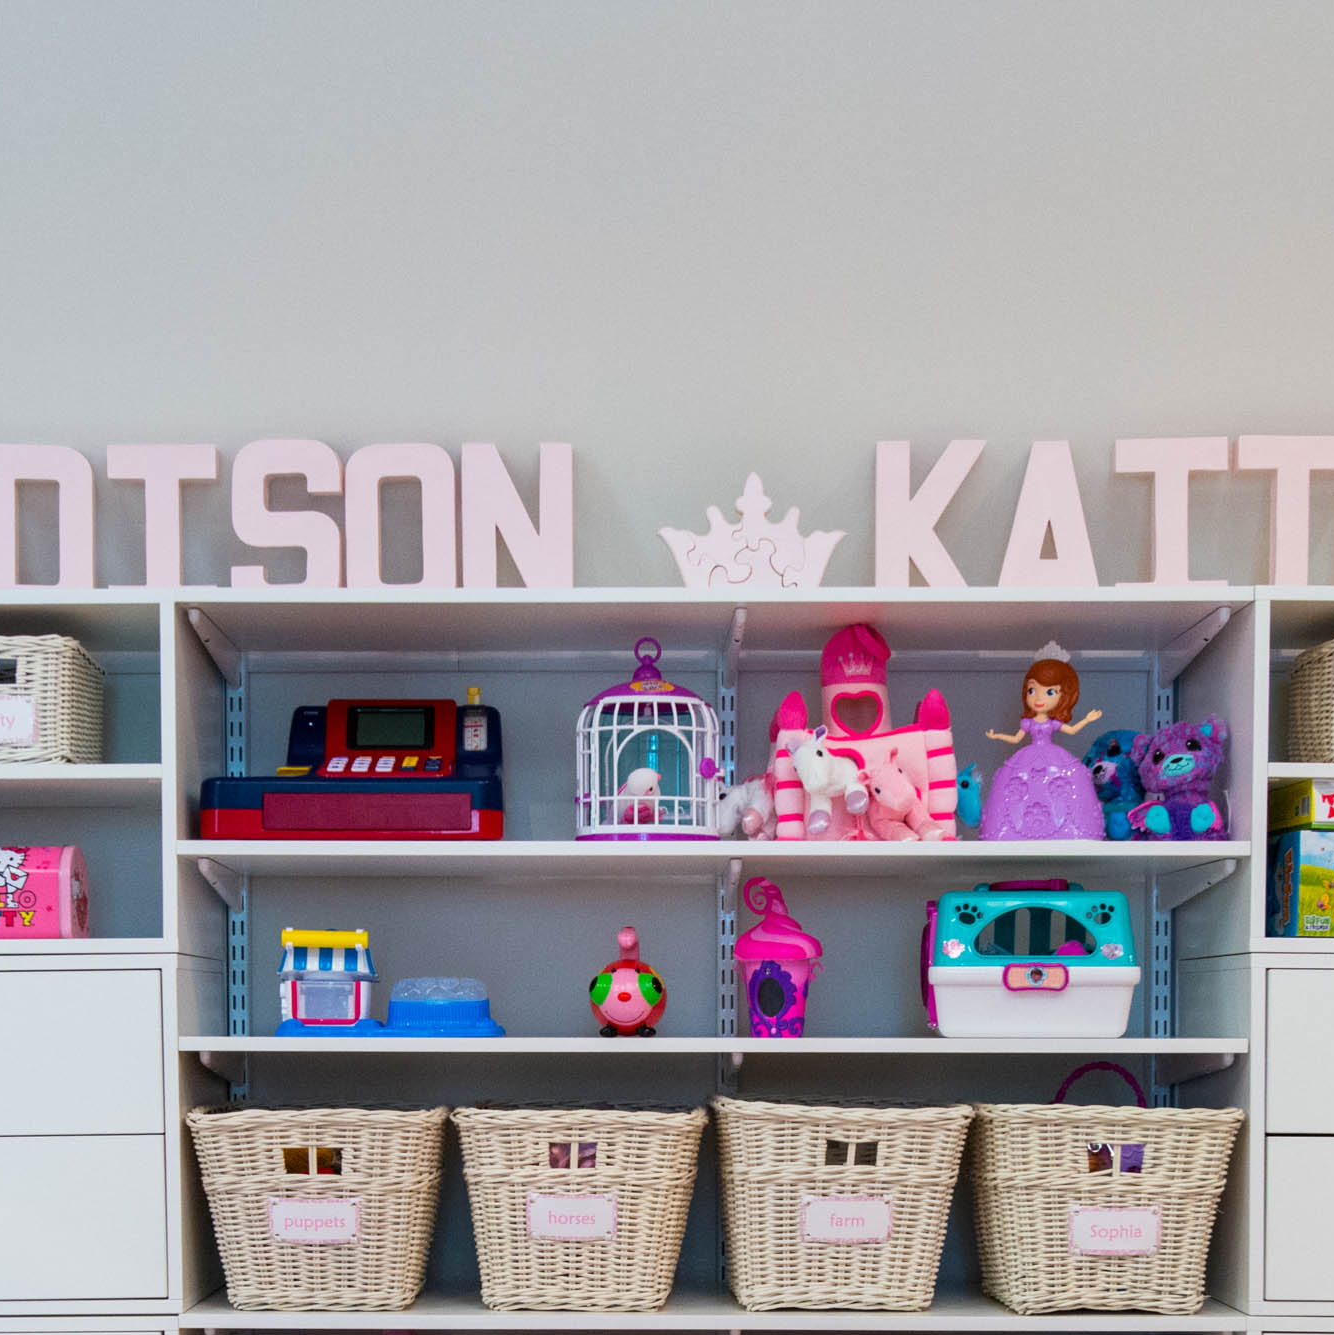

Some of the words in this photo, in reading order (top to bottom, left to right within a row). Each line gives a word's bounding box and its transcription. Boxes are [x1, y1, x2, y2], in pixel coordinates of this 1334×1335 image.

[284, 1216, 345, 1232] puppets
[548, 1211, 595, 1224] horses
[830, 1213, 865, 1227] farm
[1091, 1224, 1142, 1240] Sophia
